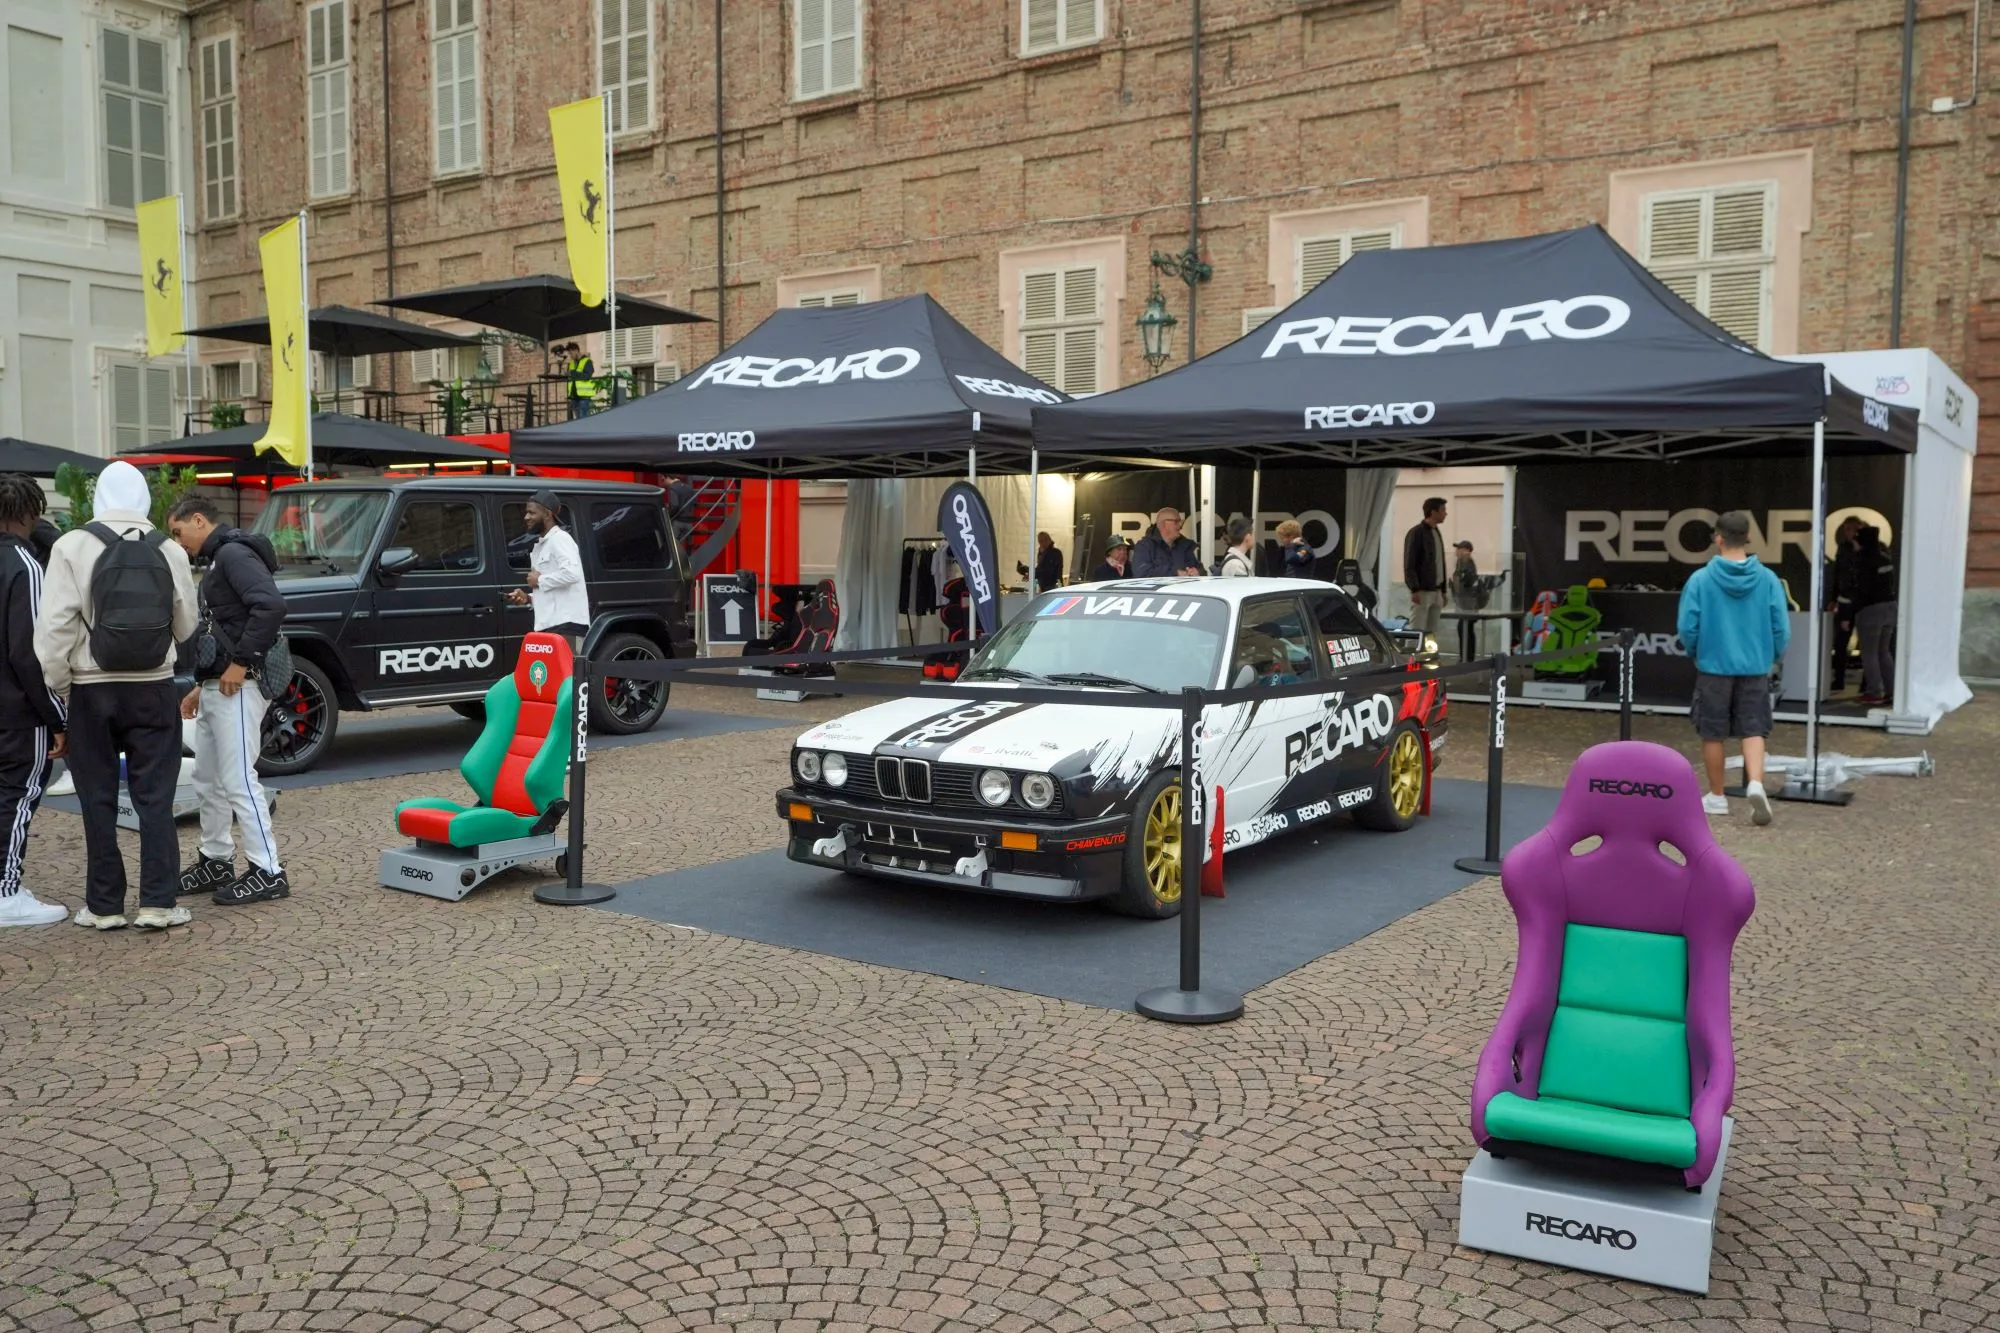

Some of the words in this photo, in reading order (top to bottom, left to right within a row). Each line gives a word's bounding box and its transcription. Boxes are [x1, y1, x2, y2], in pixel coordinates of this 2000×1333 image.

[1261, 294, 1632, 359] RECARO
[687, 347, 921, 390] RECARO
[954, 374, 1064, 405] RECARO
[1304, 401, 1436, 430] RECARO
[677, 430, 756, 452] RECARO
[1083, 596, 1202, 622] VALLI
[380, 643, 496, 675] RECARO
[525, 643, 554, 654] RECARO
[1285, 693, 1394, 779] RECARO
[1297, 800, 1331, 822] RECARO
[1338, 787, 1373, 808] RECARO
[1589, 779, 1674, 799] RECARO
[400, 866, 434, 882] RECARO
[1526, 1192, 1637, 1250] RECARO
